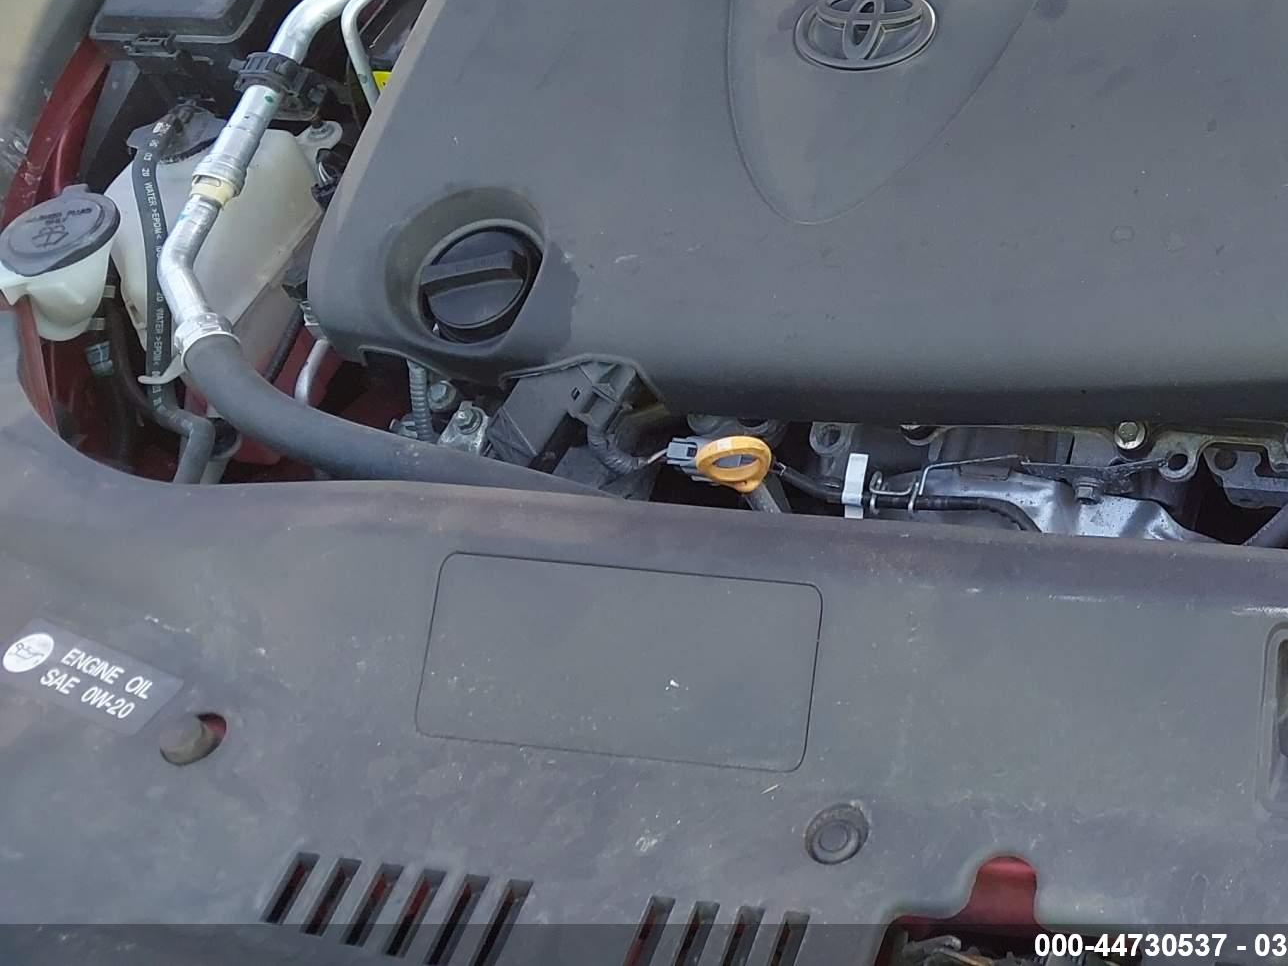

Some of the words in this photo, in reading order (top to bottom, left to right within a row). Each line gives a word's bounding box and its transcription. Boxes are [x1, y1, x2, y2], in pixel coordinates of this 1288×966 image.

[144, 182, 158, 206] WATER
[154, 308, 164, 335] WATER
[39, 668, 81, 695] SAE
[80, 685, 136, 719] 0W-20
[60, 647, 126, 685] ENGINE
[124, 675, 153, 700] OIL
